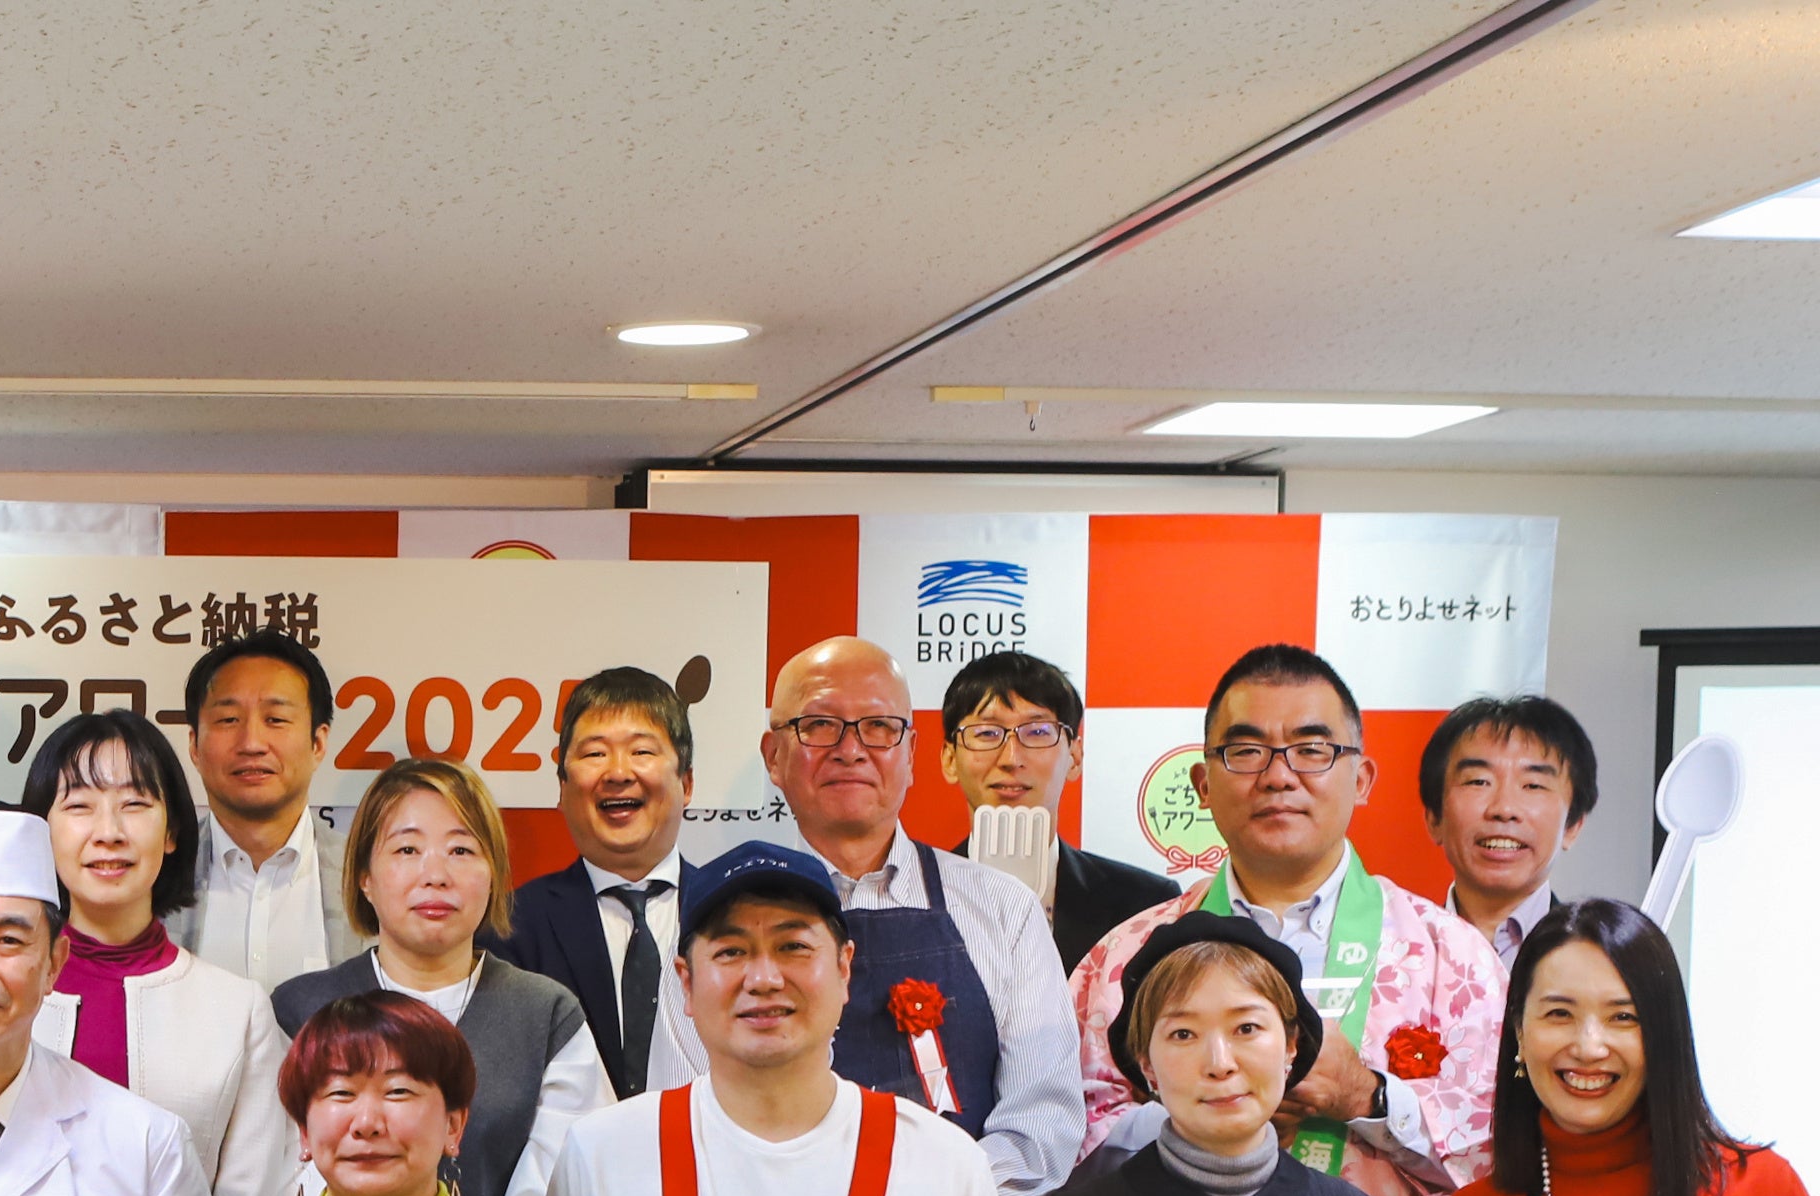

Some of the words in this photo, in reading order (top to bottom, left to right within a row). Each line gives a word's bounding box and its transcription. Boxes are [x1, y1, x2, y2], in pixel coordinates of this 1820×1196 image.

[1351, 595, 1517, 622] おとりよせネット
[918, 612, 1027, 637] LOCUS
